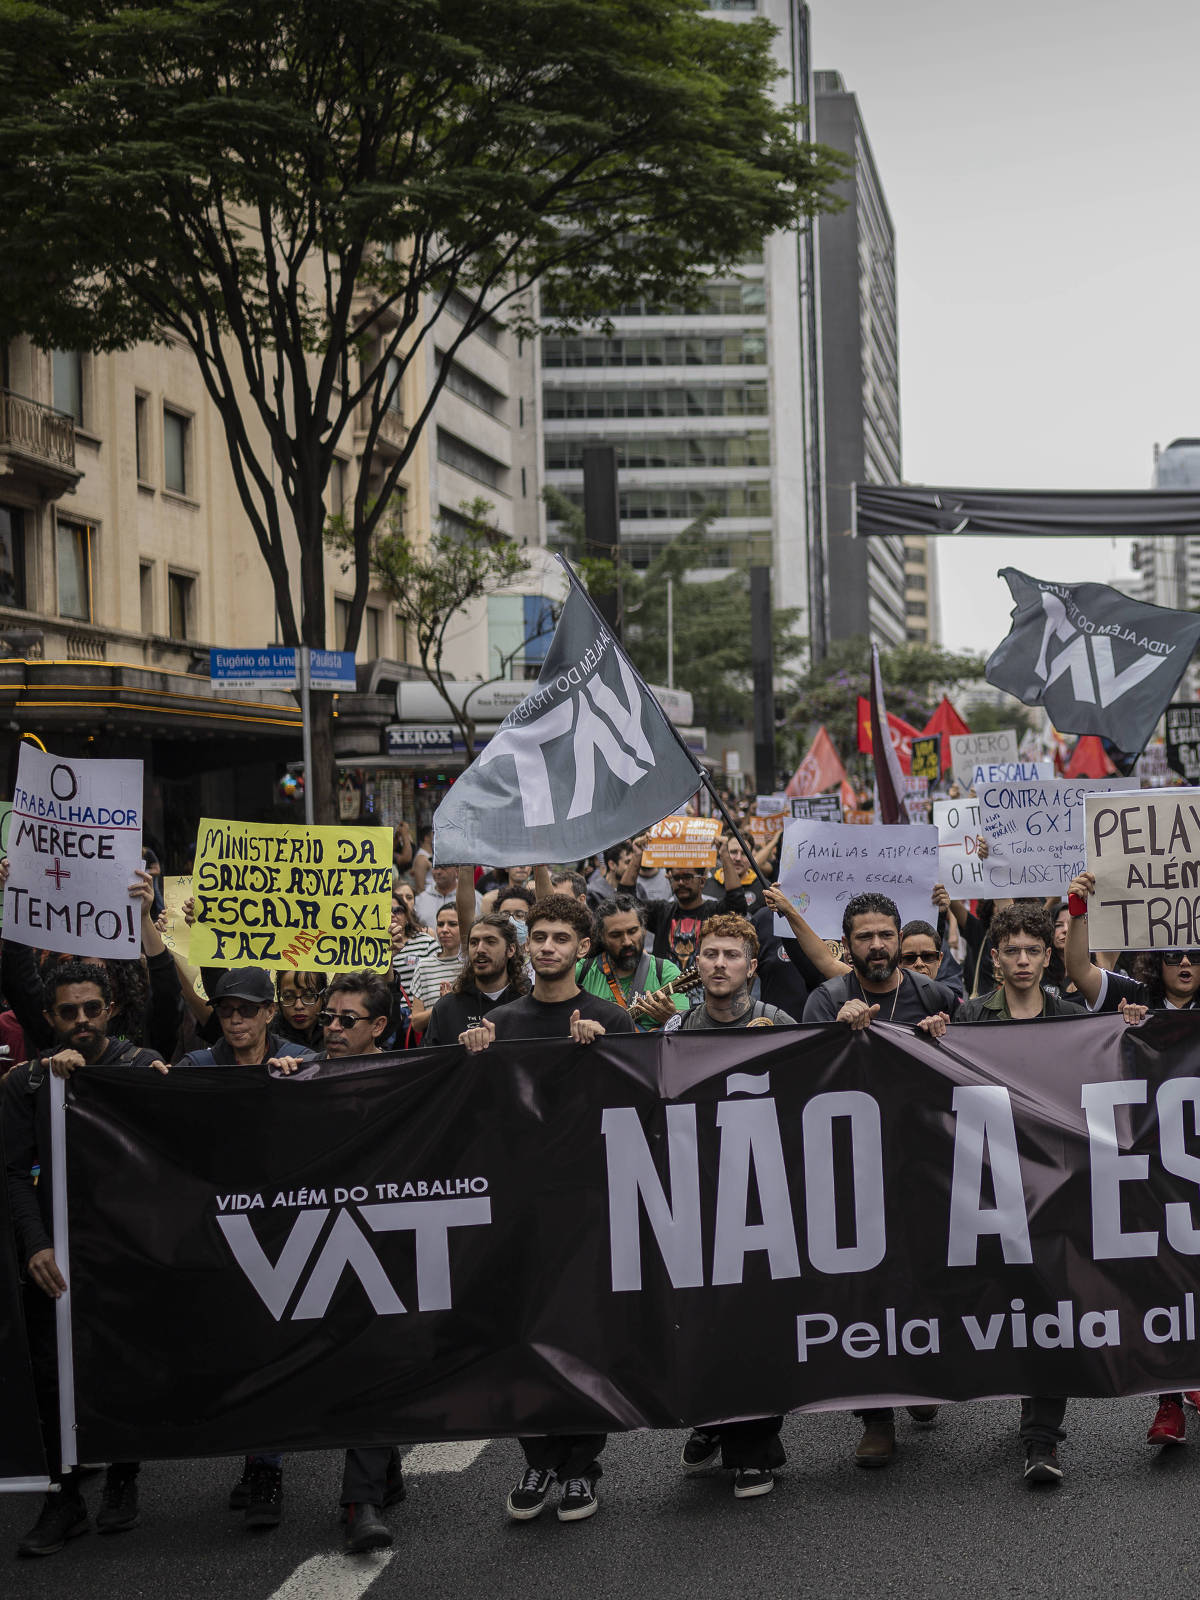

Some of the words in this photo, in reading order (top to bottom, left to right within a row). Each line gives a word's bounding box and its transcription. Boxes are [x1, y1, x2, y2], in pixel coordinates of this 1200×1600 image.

[216, 654, 255, 669] Eugênio
[258, 655, 270, 667] de
[310, 651, 342, 669] Paulista
[389, 730, 452, 745] XEROX
[955, 734, 1010, 755] QUERO
[51, 764, 78, 801] O
[974, 766, 985, 785] A
[988, 763, 1039, 784] ESCALA
[15, 787, 138, 827] TRABALHADOR
[984, 788, 1048, 809] CONTRA
[1053, 788, 1061, 806] A
[948, 808, 959, 829] O
[1026, 804, 1072, 836] 6X1
[1093, 803, 1191, 858] PELA
[15, 820, 116, 860] MERECE
[337, 839, 378, 864] DA
[878, 845, 937, 858] ATIPICAS
[1008, 841, 1034, 854] Toda
[198, 862, 282, 893] SAUDE
[285, 867, 393, 897] ADVERTE
[804, 868, 855, 883] CONTRA
[864, 873, 914, 884] ESCALA
[952, 863, 963, 885] O
[990, 863, 1053, 888] CLASSE
[7, 886, 136, 944] TEMPO!
[197, 894, 321, 930] ESCALA
[331, 902, 386, 931] 6X1
[211, 927, 282, 961] FAZ
[281, 929, 328, 968] MAL
[313, 929, 392, 968] SAÚDE
[216, 1192, 266, 1212] VIDA
[271, 1186, 328, 1208] ALÉM
[334, 1185, 369, 1204] DO
[375, 1176, 489, 1200] TRABALHO
[601, 1071, 887, 1292] NÃO
[948, 1085, 1034, 1268] A
[215, 1196, 492, 1322] VAT
[796, 1307, 941, 1363] Pela
[962, 1298, 1121, 1352] vida
